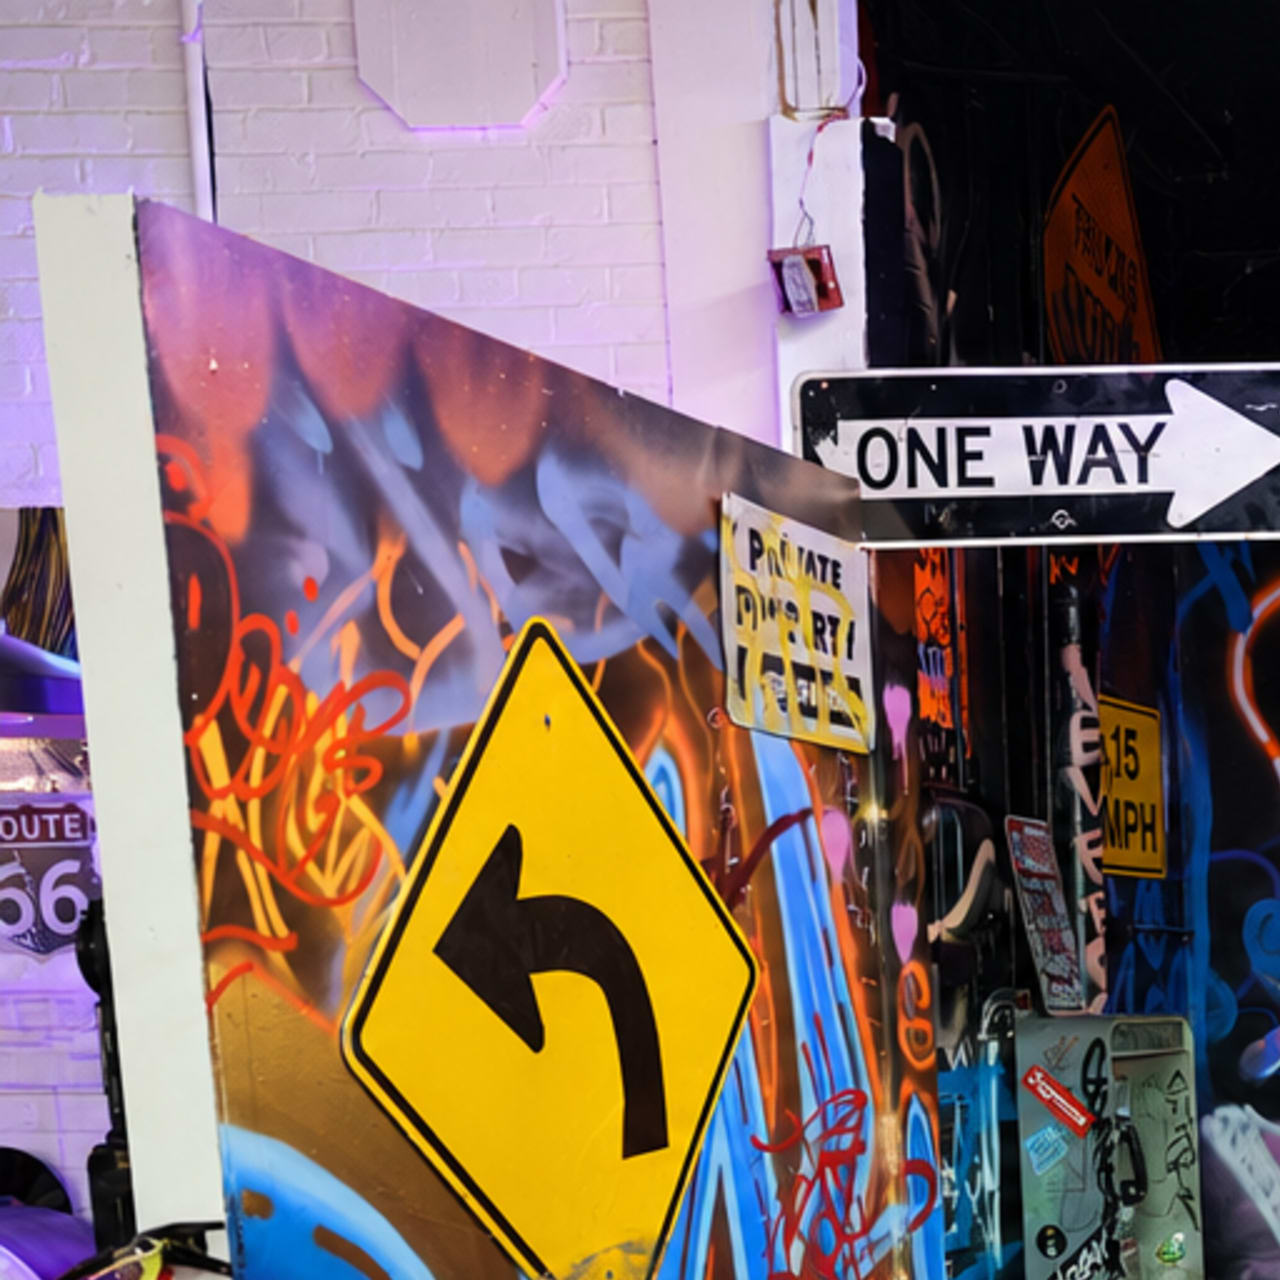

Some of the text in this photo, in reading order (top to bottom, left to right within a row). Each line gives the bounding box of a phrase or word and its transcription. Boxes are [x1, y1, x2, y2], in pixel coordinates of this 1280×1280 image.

[856, 421, 1167, 490] ONE WAY
[1110, 725, 1140, 782] 15
[1103, 800, 1157, 854] MPH
